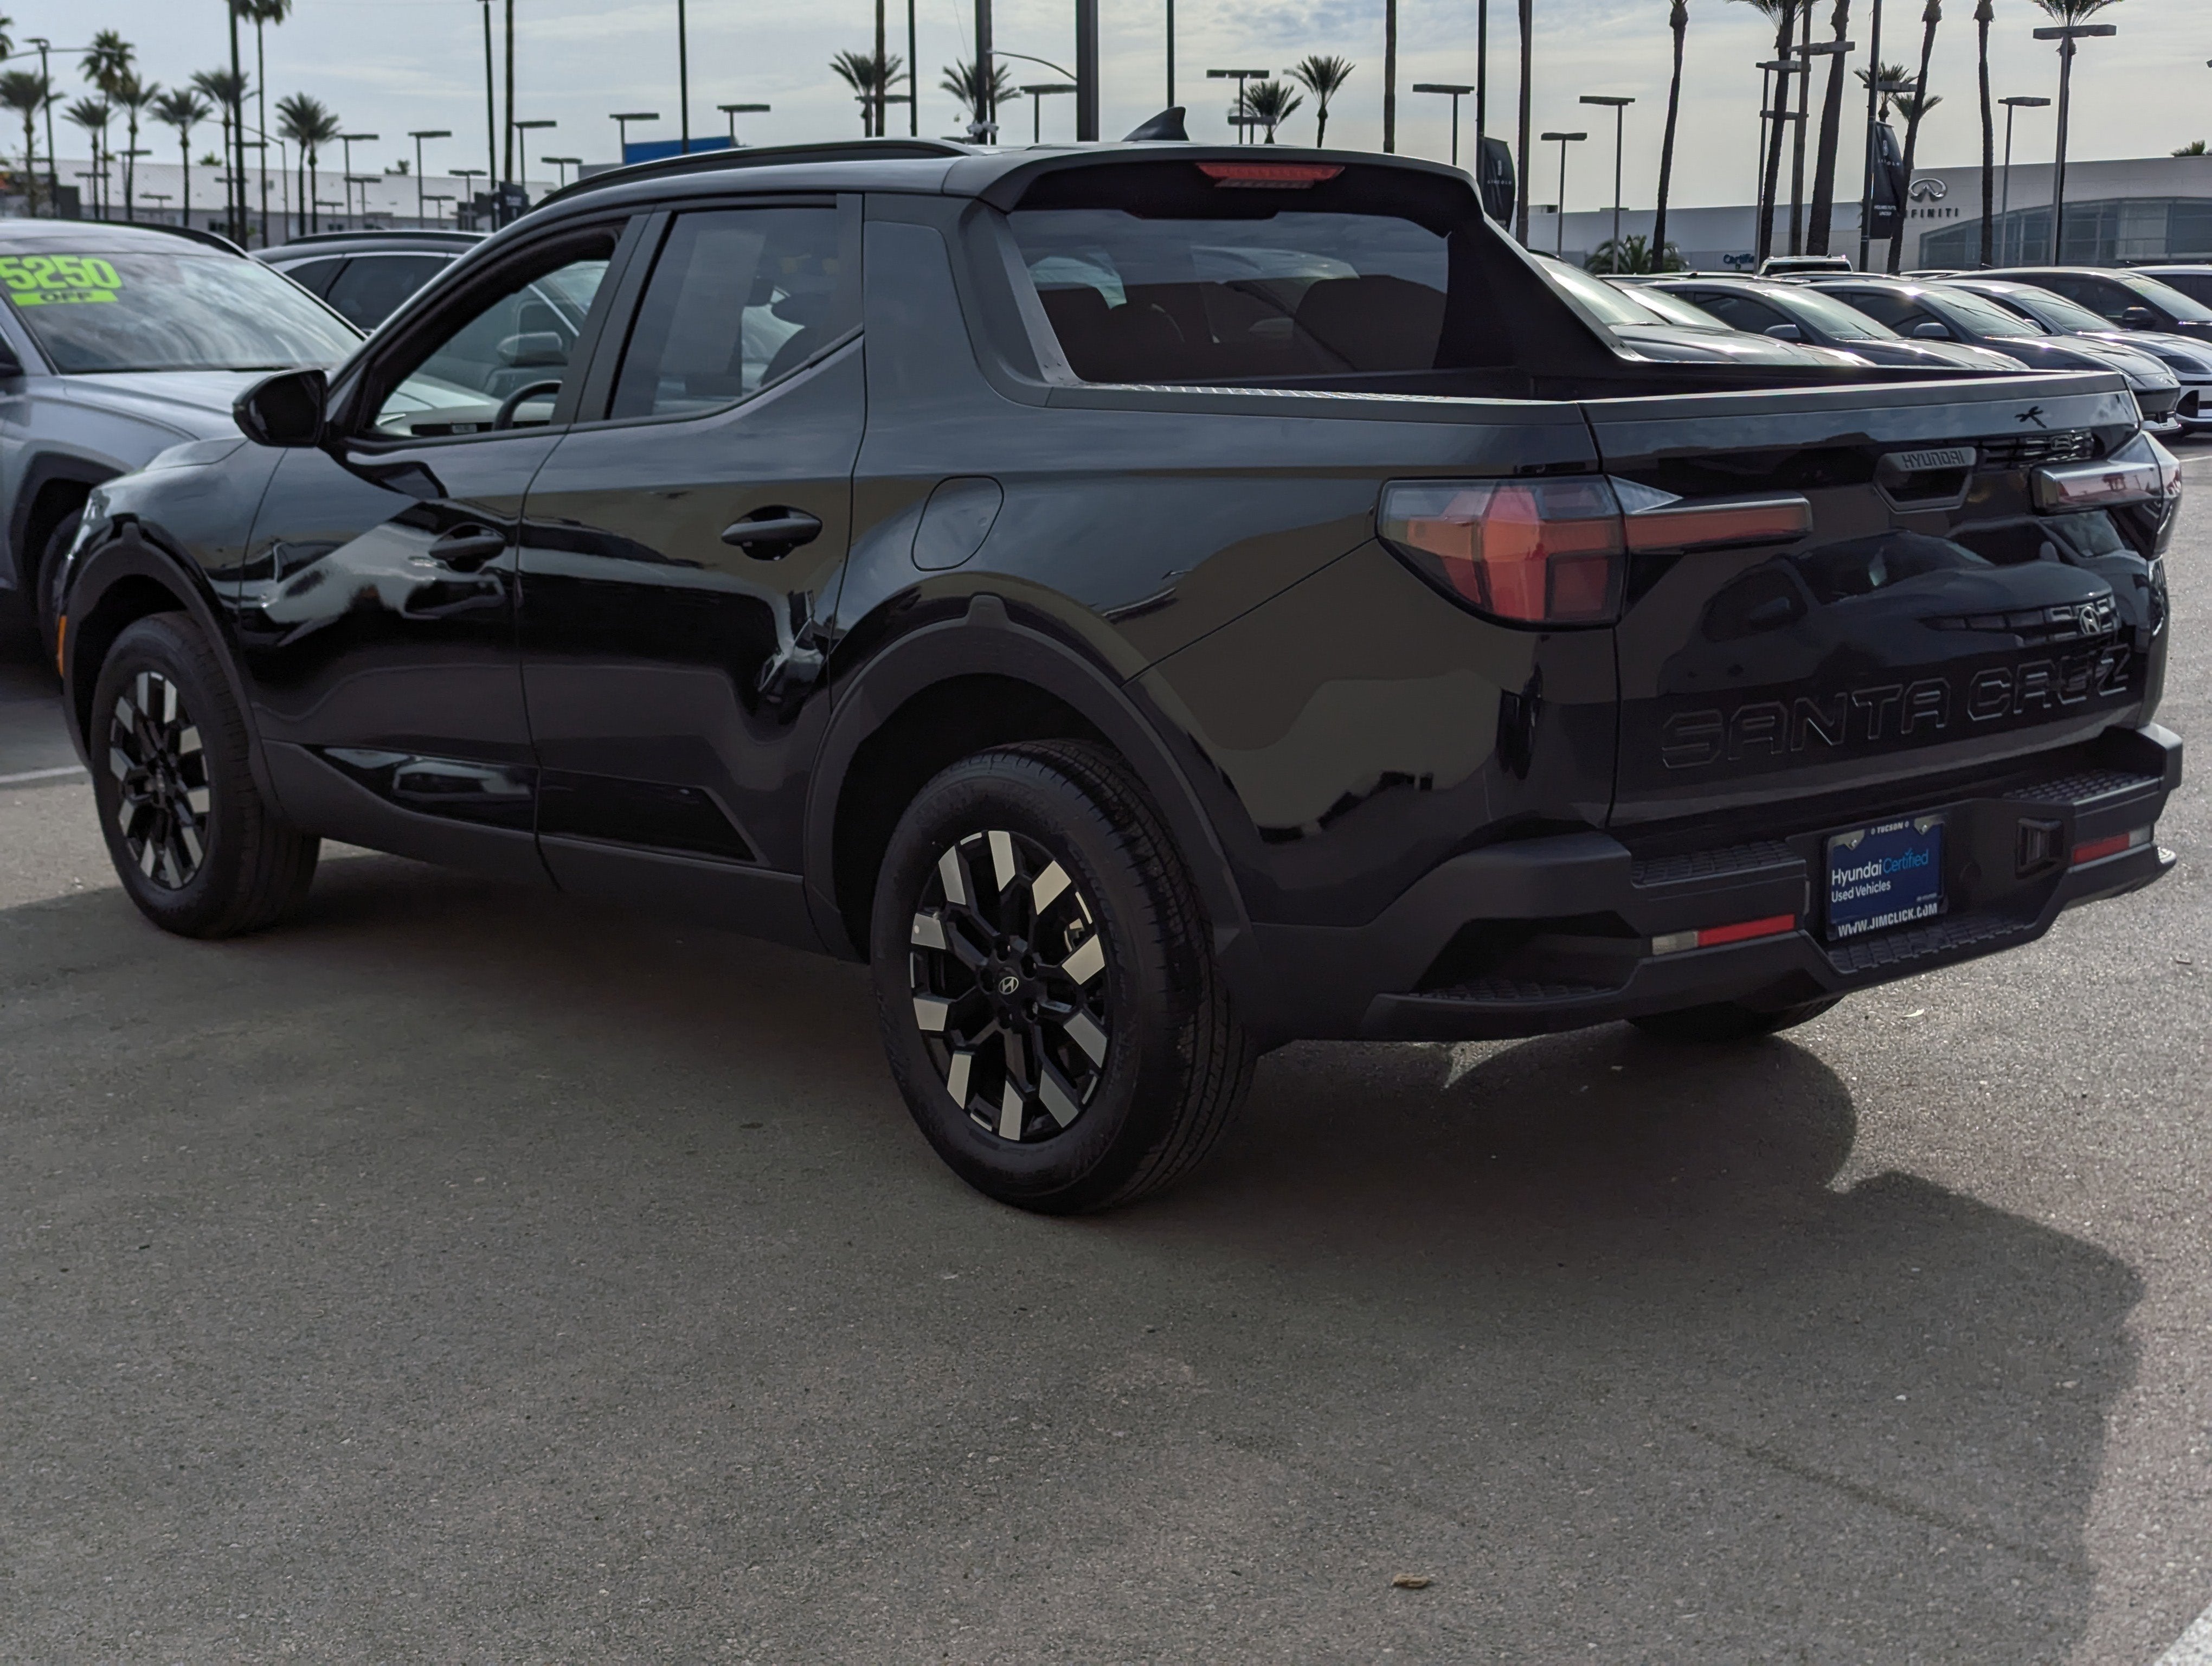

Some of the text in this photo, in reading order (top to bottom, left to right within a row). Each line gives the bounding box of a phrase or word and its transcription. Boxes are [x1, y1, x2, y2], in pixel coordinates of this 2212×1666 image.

[1905, 208, 1959, 218] FINITI
[1901, 450, 1965, 469] HYUNDAI
[1662, 643, 2131, 768] SANTA CRUZ
[1876, 822, 1904, 834] TUCSON
[1831, 848, 1929, 887] Hyundai Certified
[1831, 880, 1892, 903] Used Vehicles
[1837, 902, 1938, 938] WWW.JIMCLICK.COM
